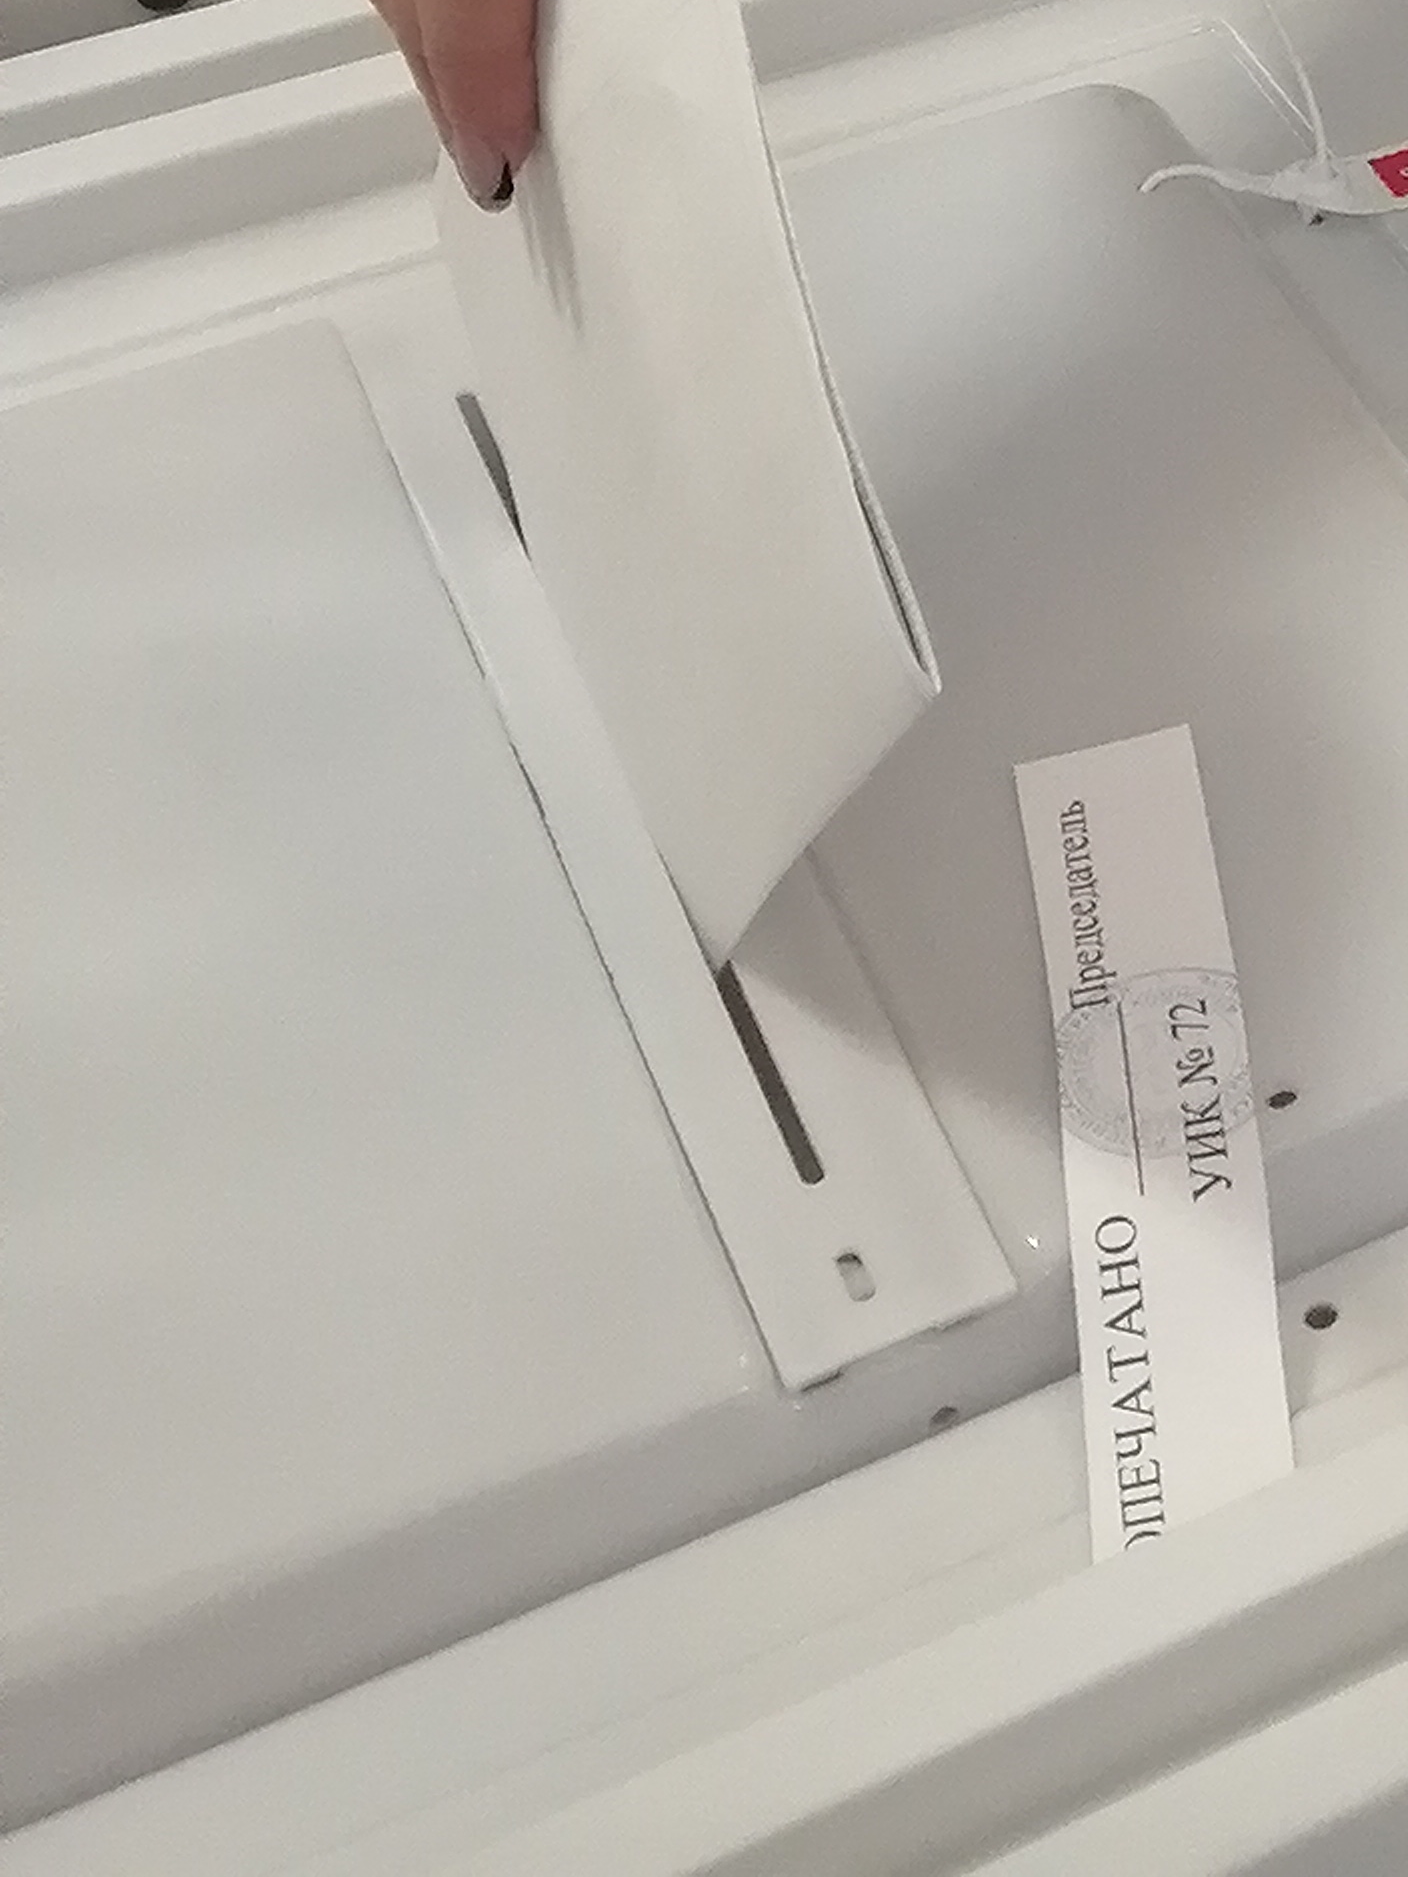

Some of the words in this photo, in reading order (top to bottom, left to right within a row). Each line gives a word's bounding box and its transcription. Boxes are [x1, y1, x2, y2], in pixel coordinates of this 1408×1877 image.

[1059, 799, 1118, 1011] Председатель
[1168, 998, 1211, 1042] 72
[1175, 1045, 1219, 1089] №
[1179, 1093, 1233, 1204] УИК
